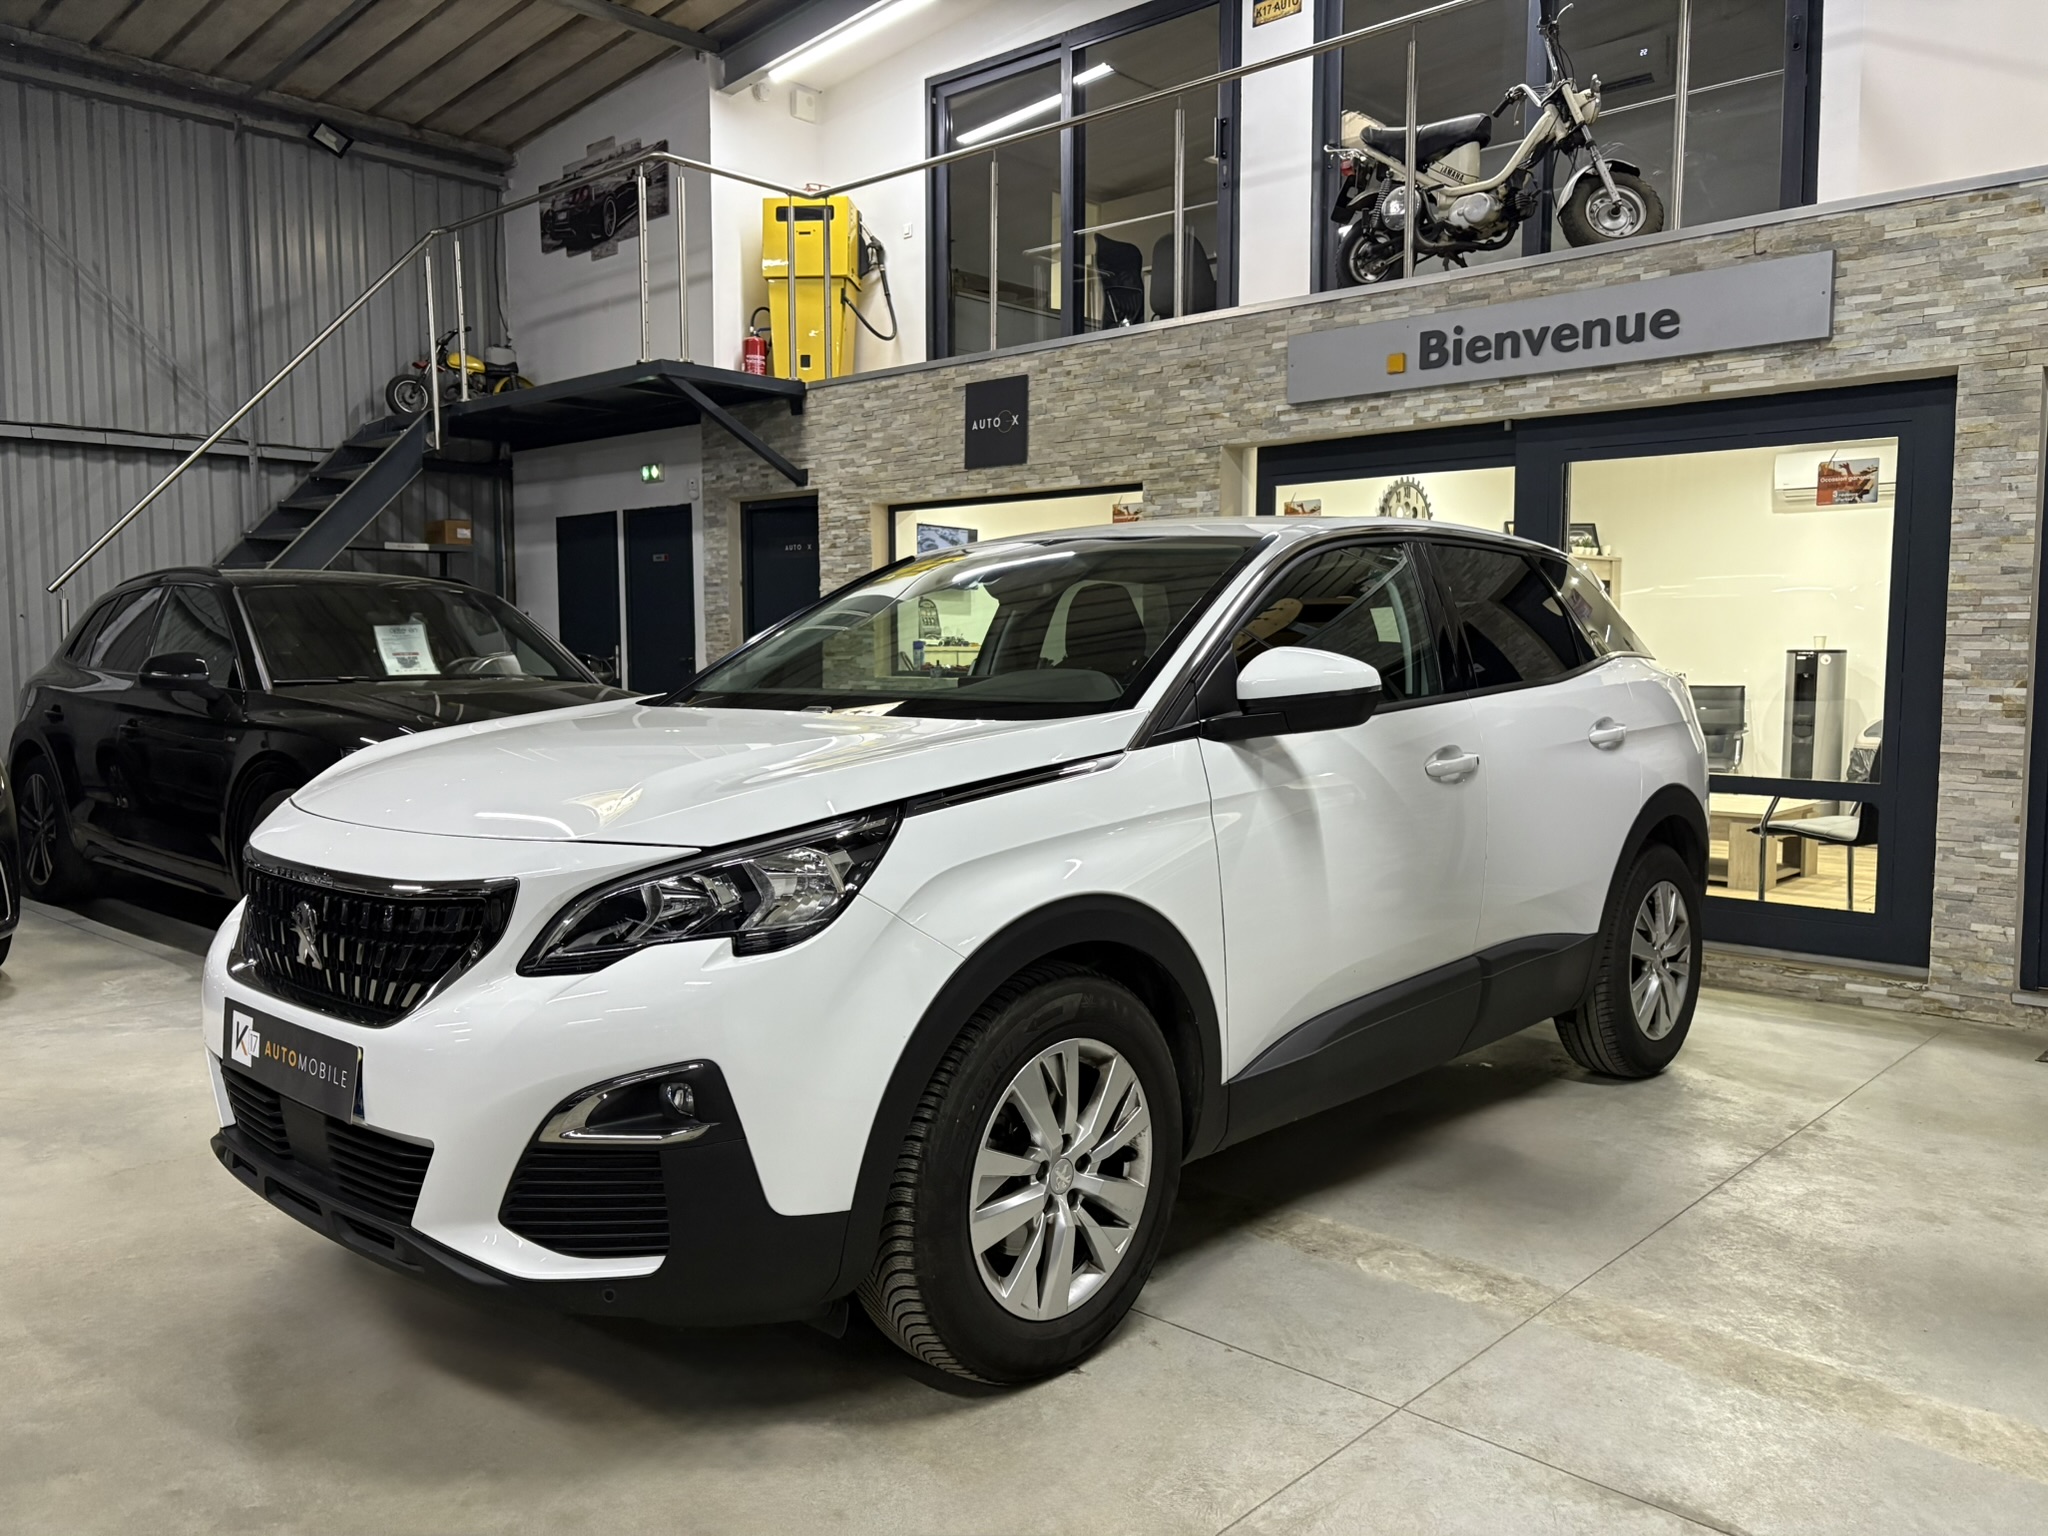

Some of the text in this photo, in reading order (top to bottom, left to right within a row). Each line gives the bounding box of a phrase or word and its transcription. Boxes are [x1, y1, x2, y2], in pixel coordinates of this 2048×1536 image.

[1439, 165, 1465, 183] YAMAHA
[1418, 308, 1681, 371] Bienvenue
[971, 414, 1019, 431] AUTO X
[264, 1040, 348, 1088] AUTOMOBILE
